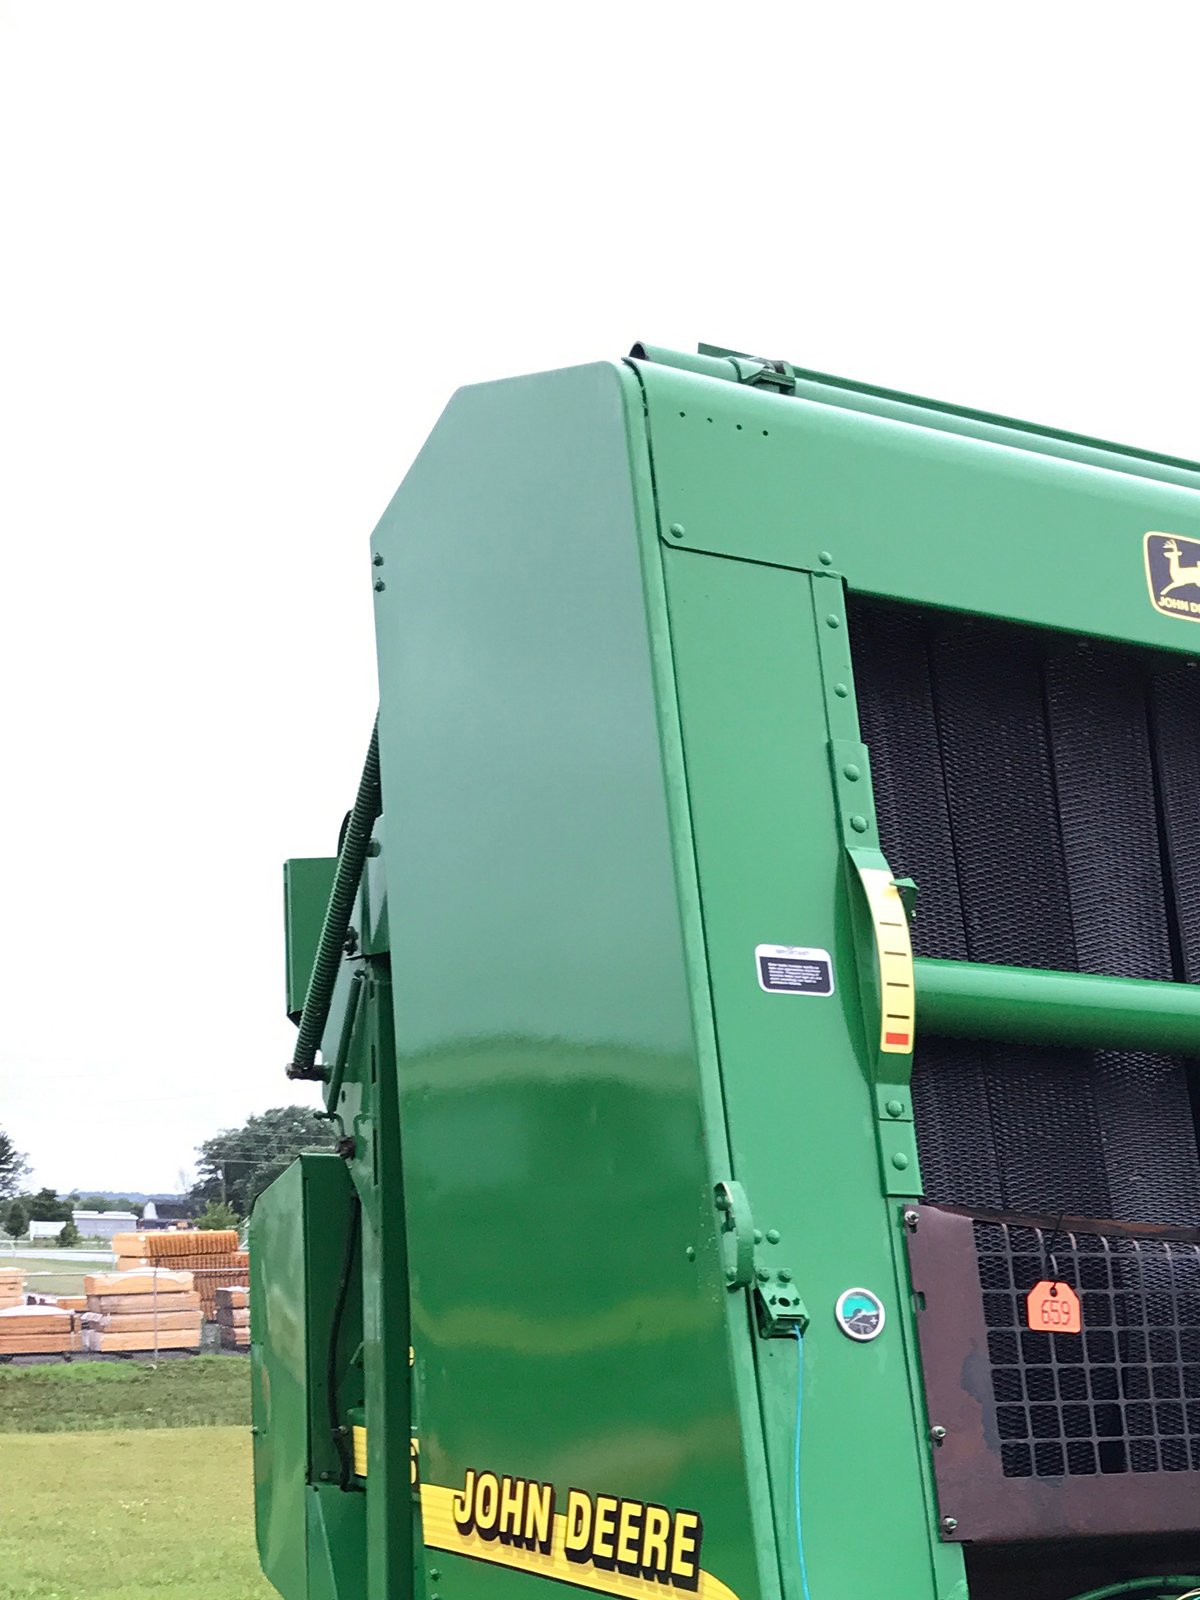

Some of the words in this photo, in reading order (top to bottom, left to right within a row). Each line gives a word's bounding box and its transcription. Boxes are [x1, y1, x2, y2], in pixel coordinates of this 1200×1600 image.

[1158, 596, 1189, 611] JOHN
[1041, 1299, 1071, 1325] 659
[453, 1468, 555, 1552] JOHN
[564, 1487, 703, 1588] DEERE
